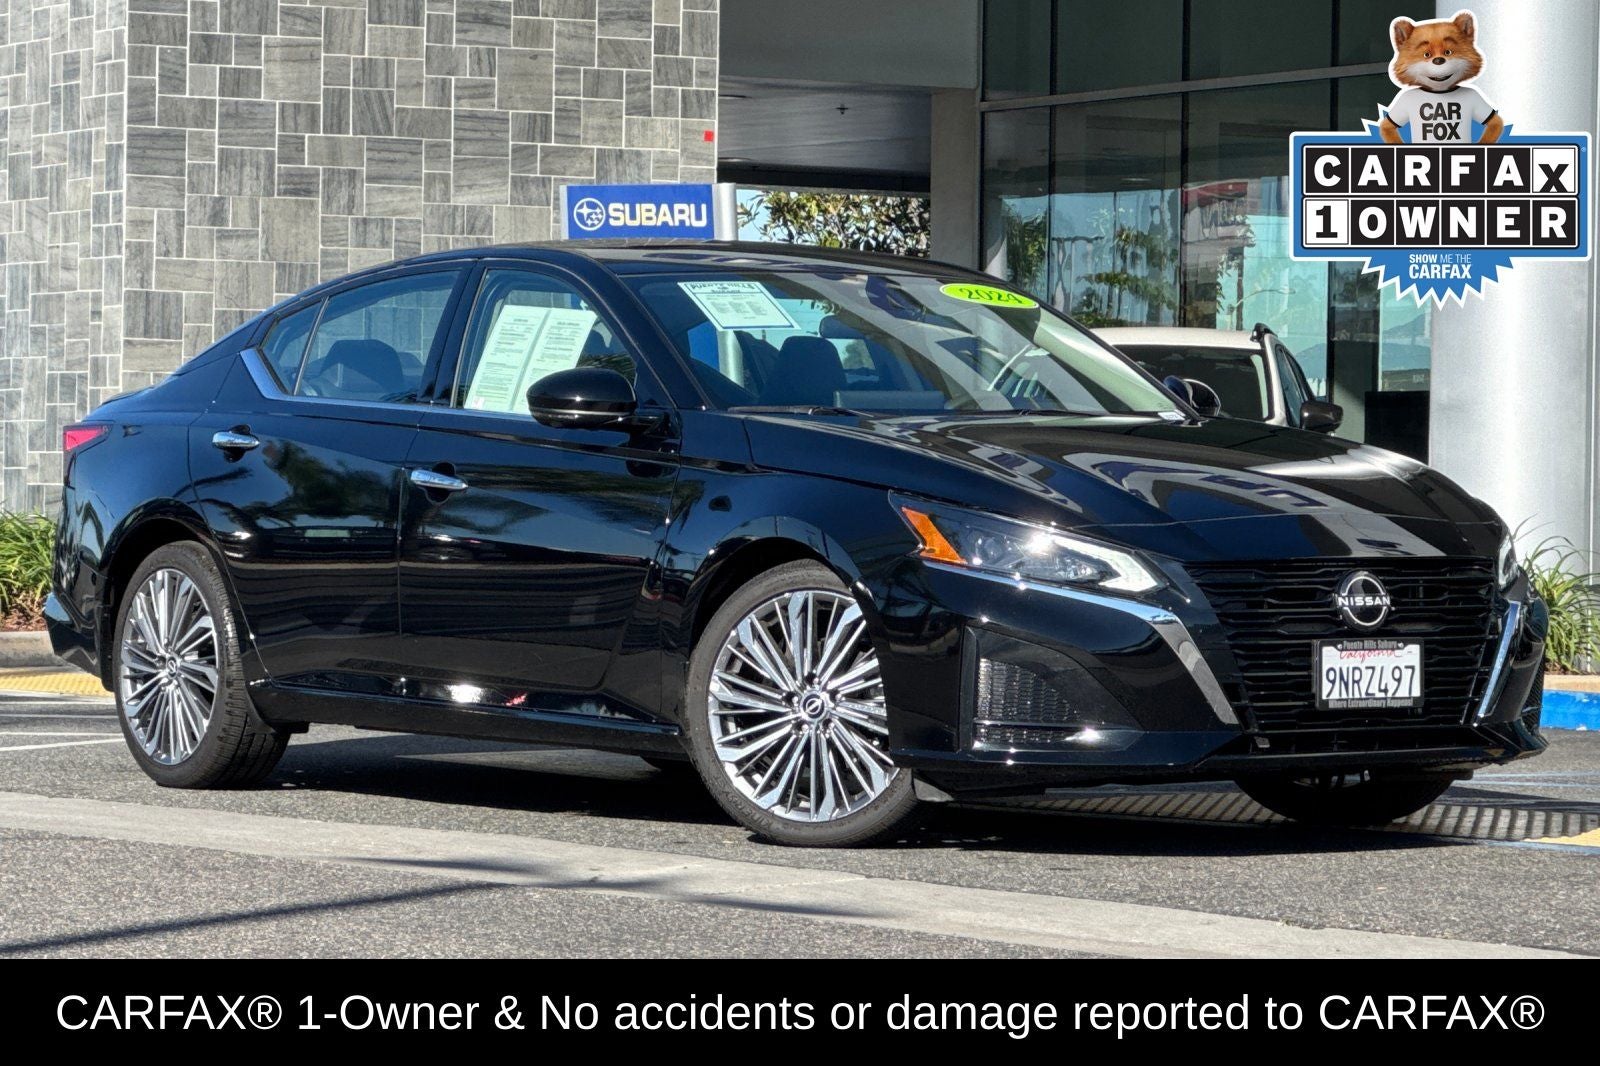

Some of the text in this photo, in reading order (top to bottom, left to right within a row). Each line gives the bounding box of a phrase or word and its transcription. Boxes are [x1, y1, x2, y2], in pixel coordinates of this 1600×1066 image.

[608, 202, 707, 227] SUBARU
[959, 287, 1024, 304] 2024
[1338, 596, 1391, 607] NISSAN
[1325, 665, 1416, 698] 9NRZ497
